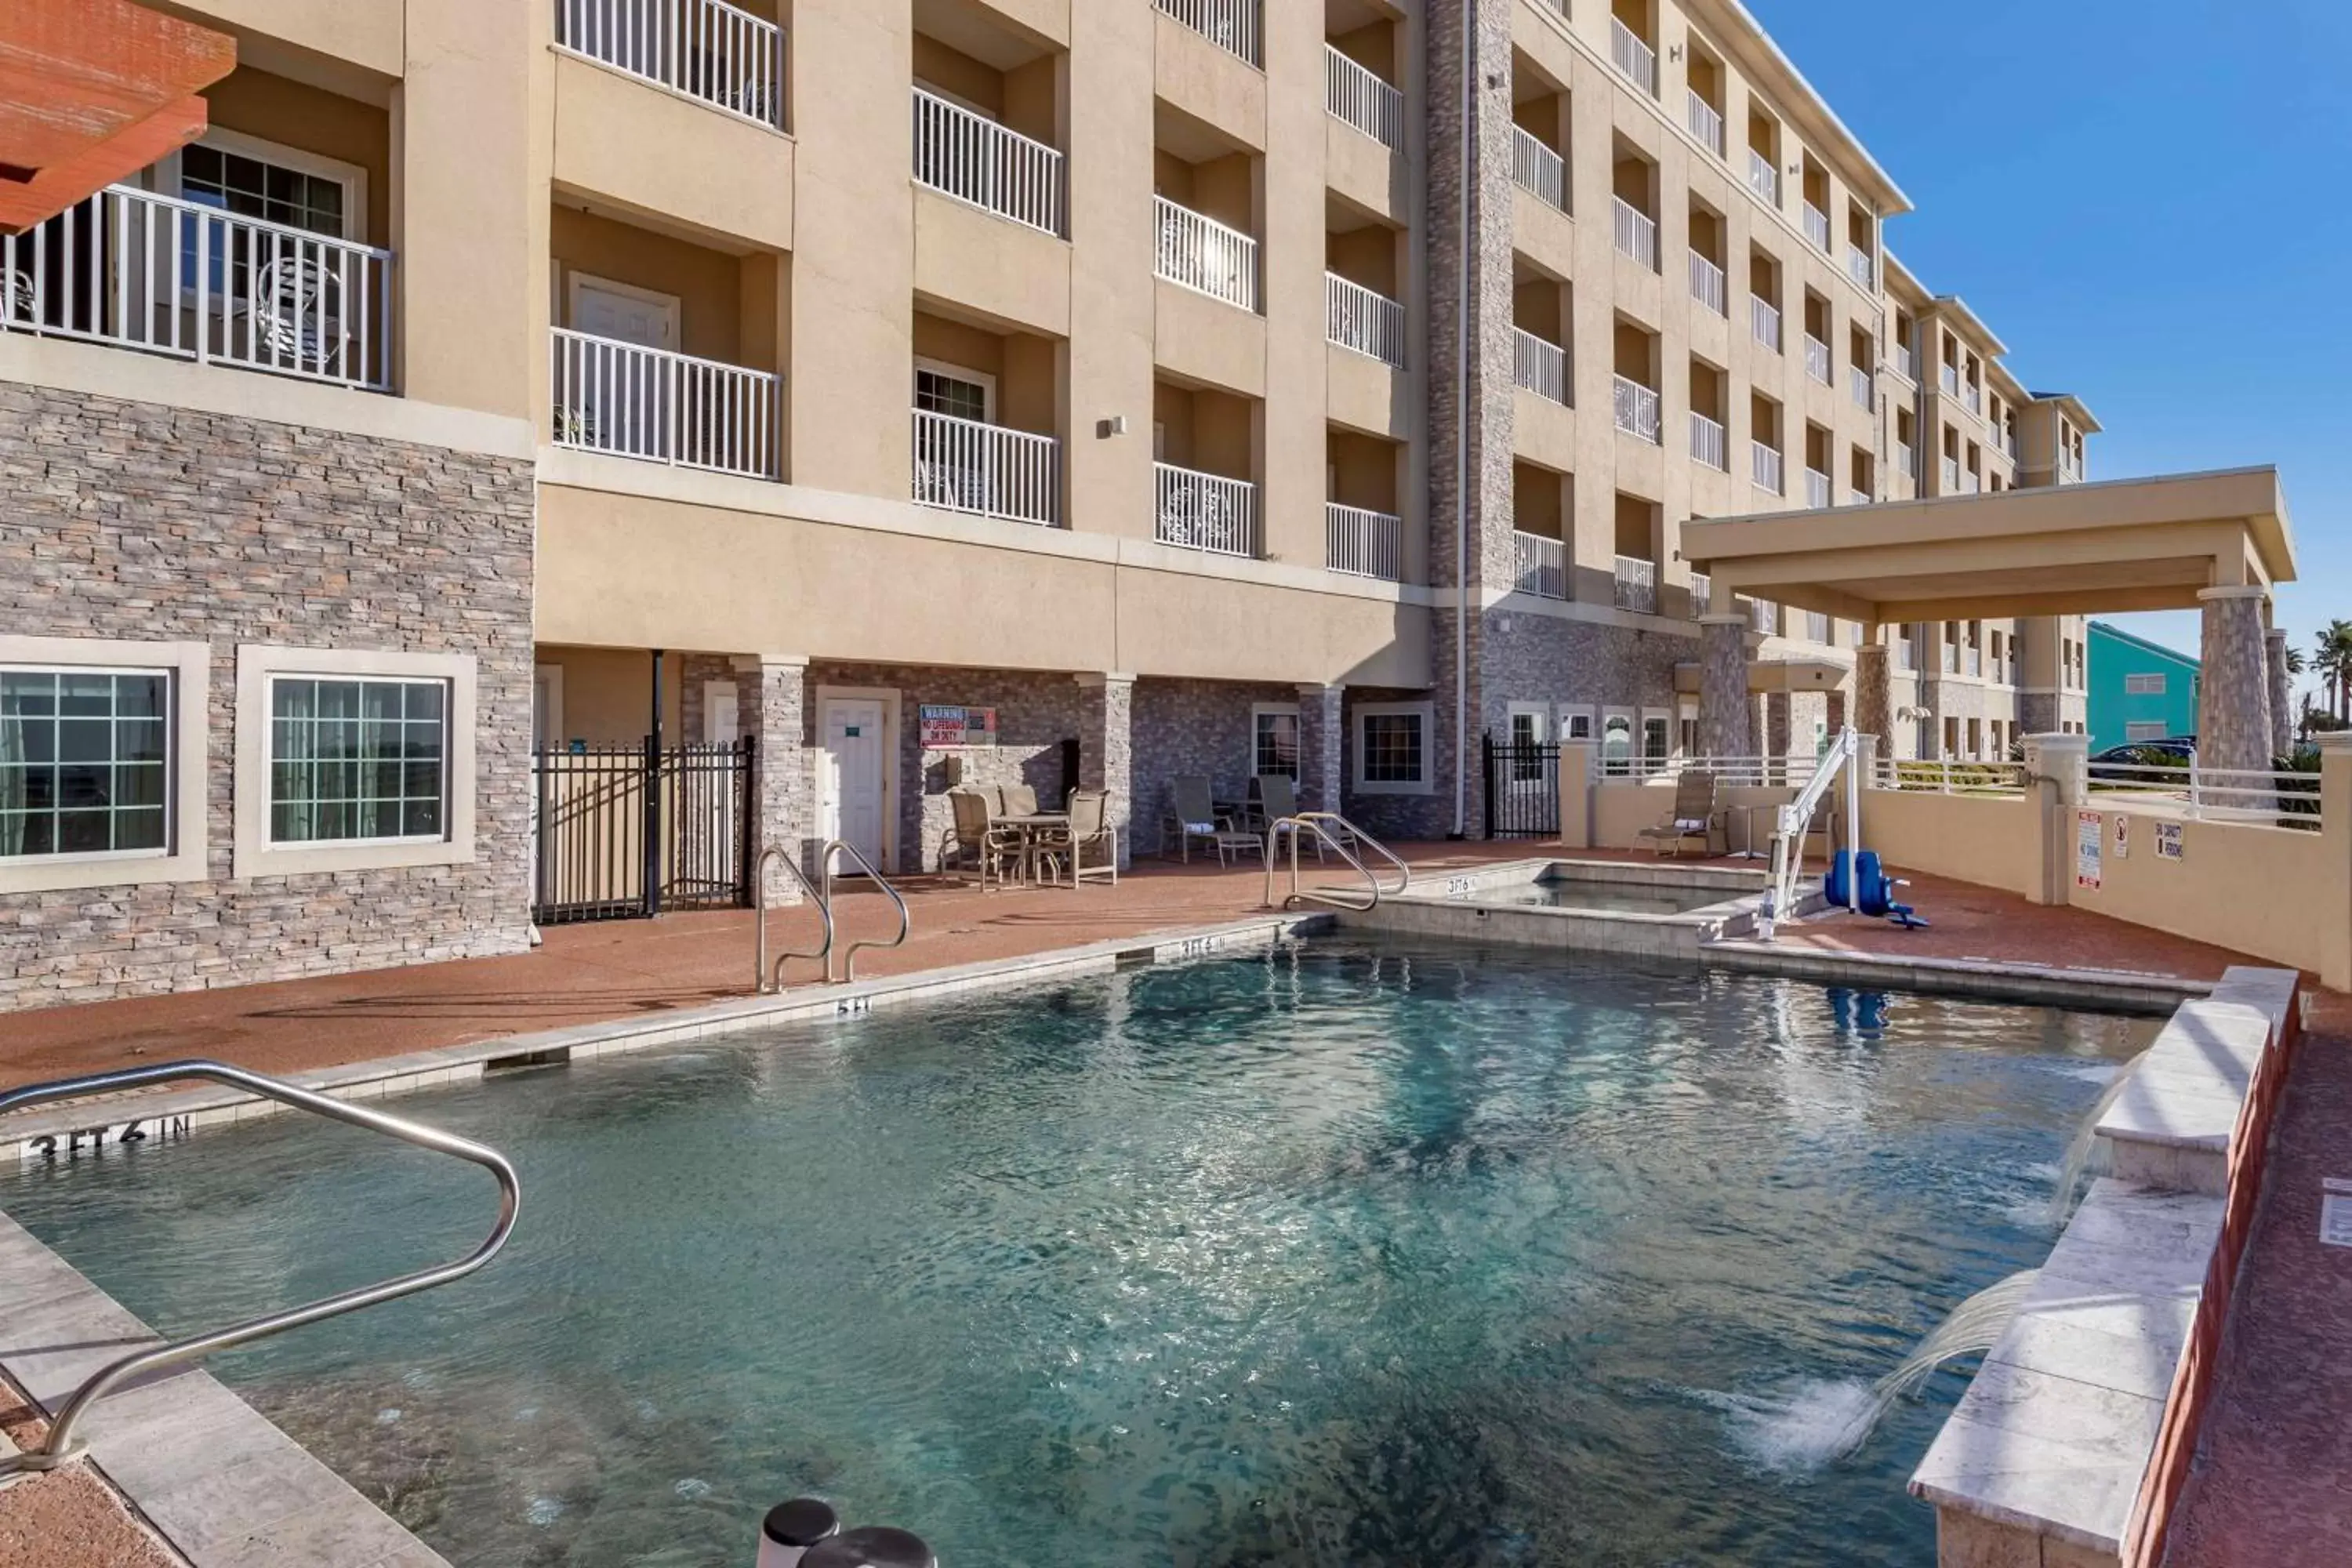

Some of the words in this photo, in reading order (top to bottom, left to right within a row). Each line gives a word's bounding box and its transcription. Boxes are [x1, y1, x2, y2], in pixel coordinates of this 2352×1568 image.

[925, 707, 964, 719] WARNING
[923, 720, 931, 729] NO
[70, 1127, 109, 1152] FT
[161, 1115, 190, 1136] IN
